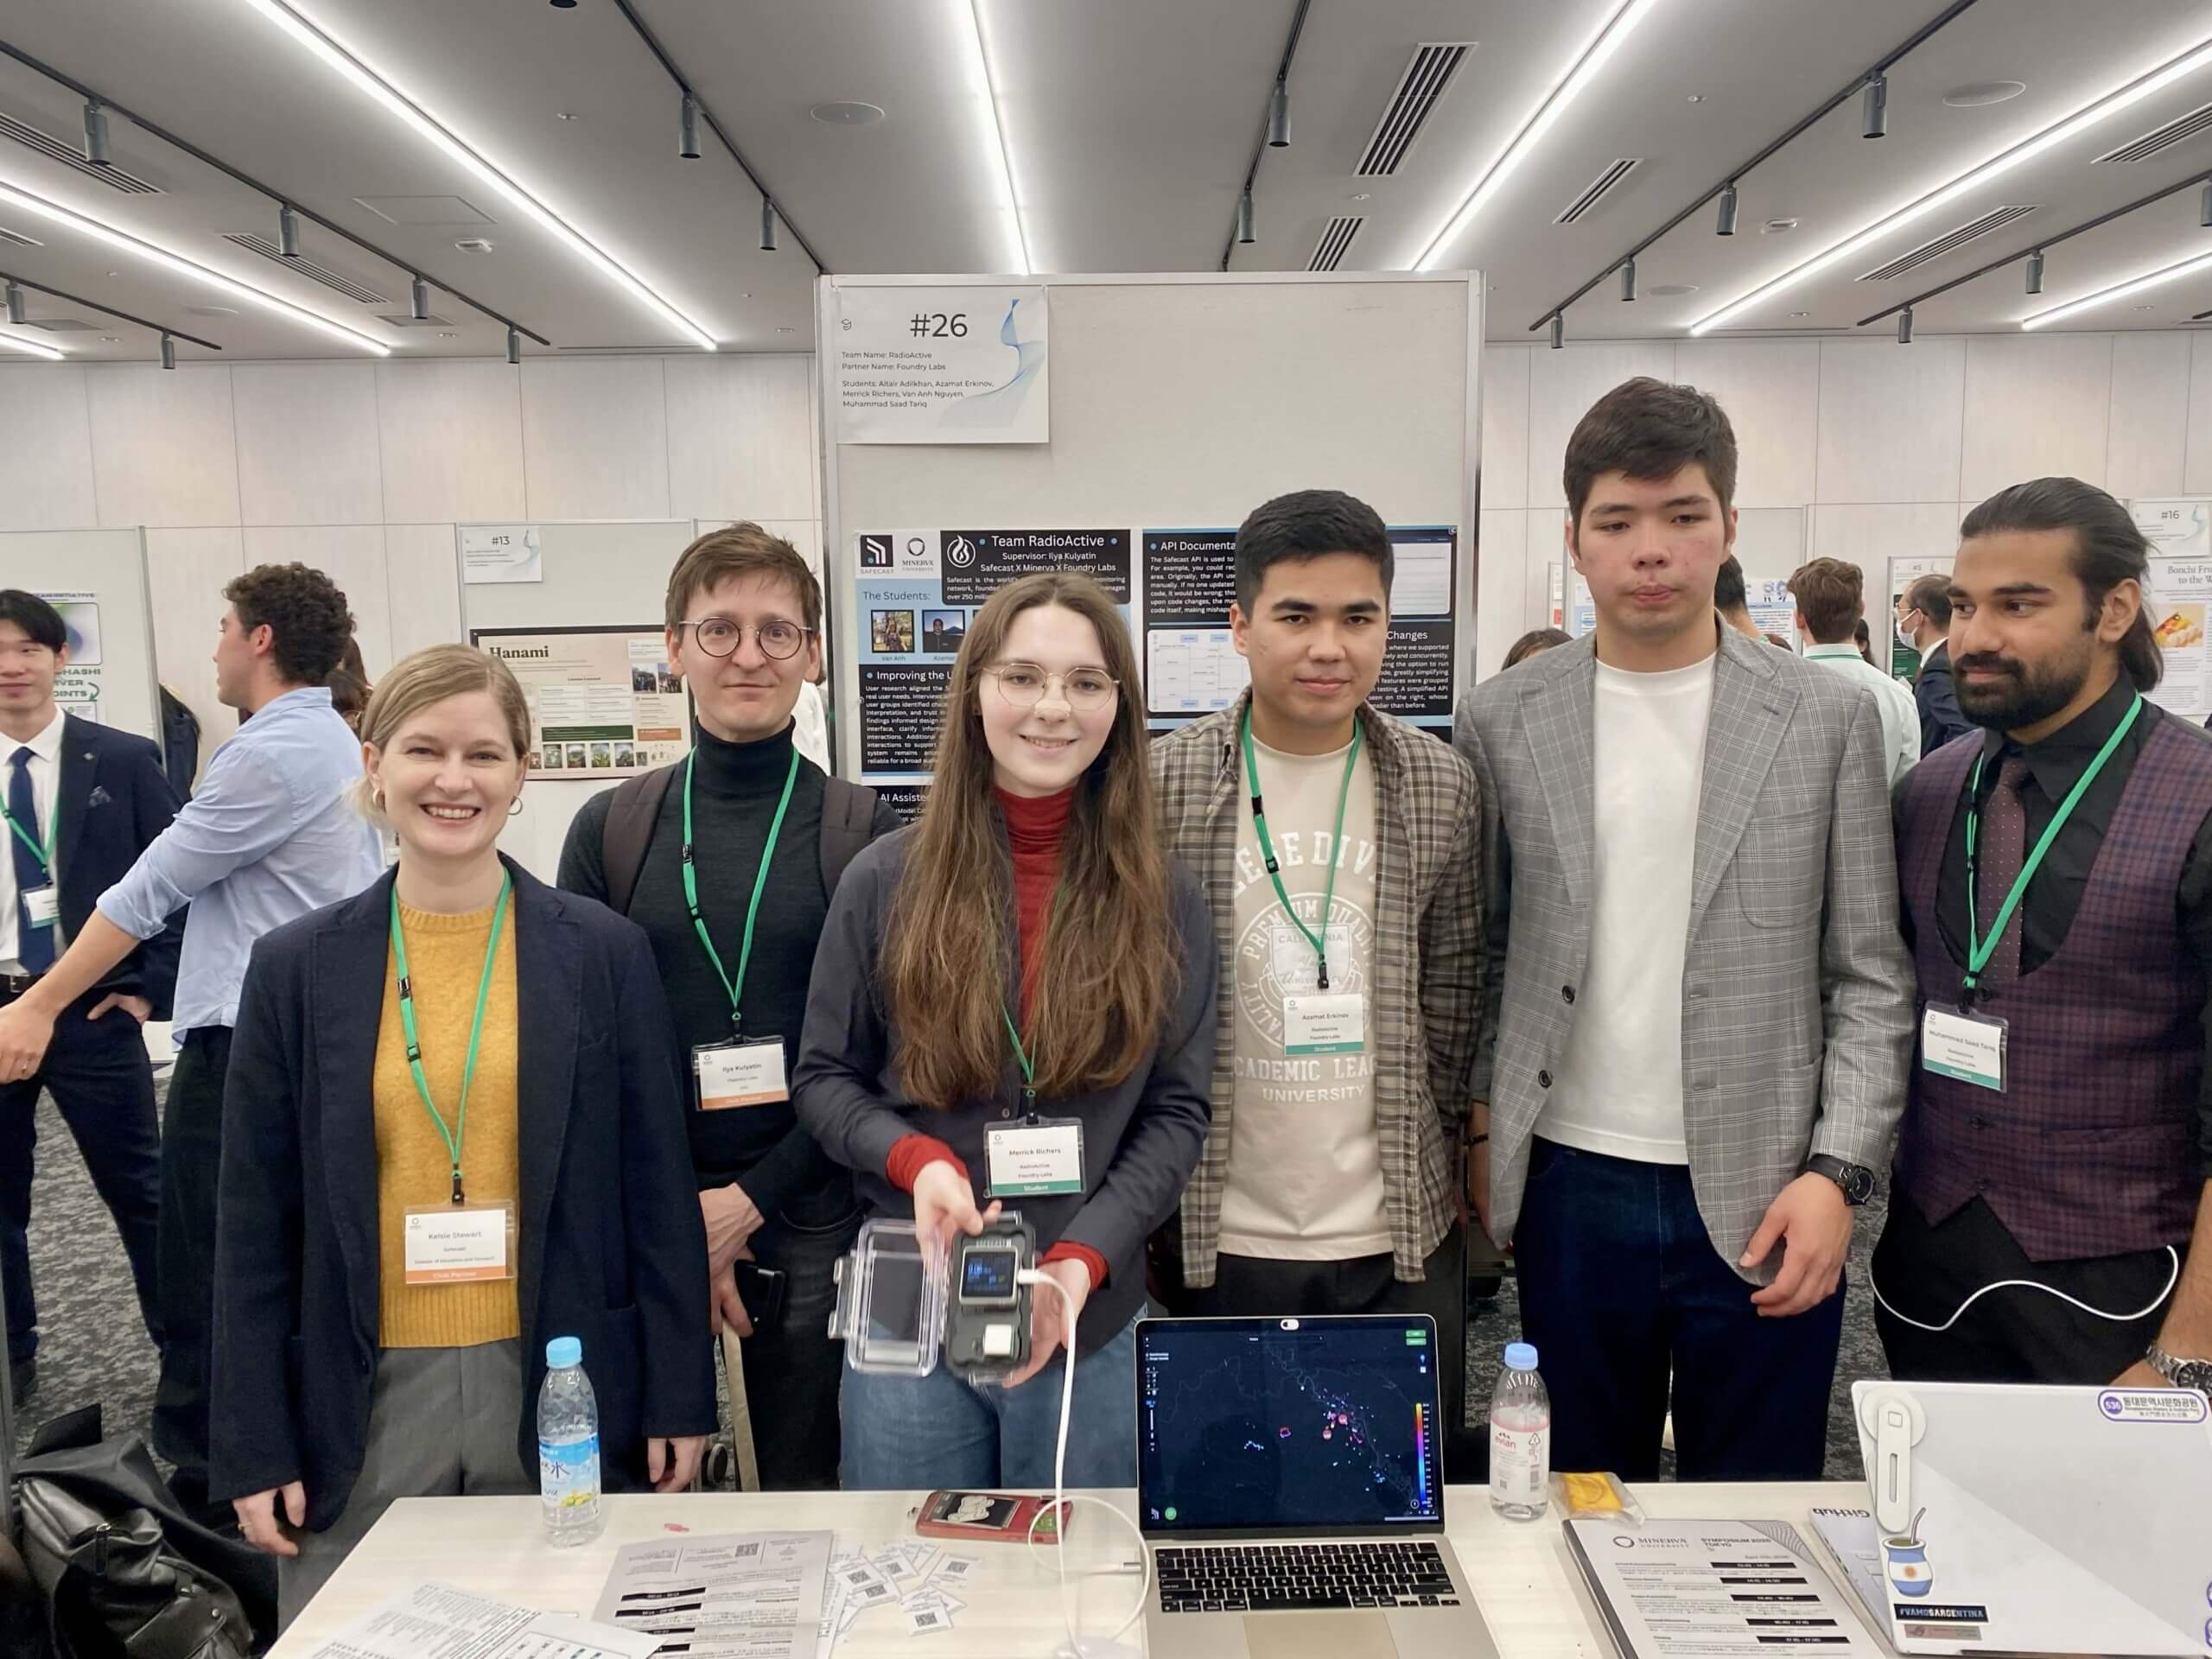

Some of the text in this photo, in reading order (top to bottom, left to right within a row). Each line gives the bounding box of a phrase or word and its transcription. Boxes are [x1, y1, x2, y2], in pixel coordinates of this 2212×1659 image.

[910, 314, 968, 338] #26
[491, 536, 510, 546] #13
[992, 535, 1104, 547] Team RadioActive
[1160, 542, 1236, 550] API Documenta
[1387, 631, 1427, 641] Changes
[490, 645, 549, 658] Hanami
[877, 671, 926, 682] Improving
[880, 793, 926, 802] AI Assiste
[1234, 1056, 1320, 1082] CADEMIC
[1262, 1085, 1365, 1103] UNIVERSITY
[1495, 1435, 1516, 1449] evian
[1813, 1509, 1870, 1517] GitHub
[1900, 1608, 1983, 1618] #VAMOSARGENTINA
